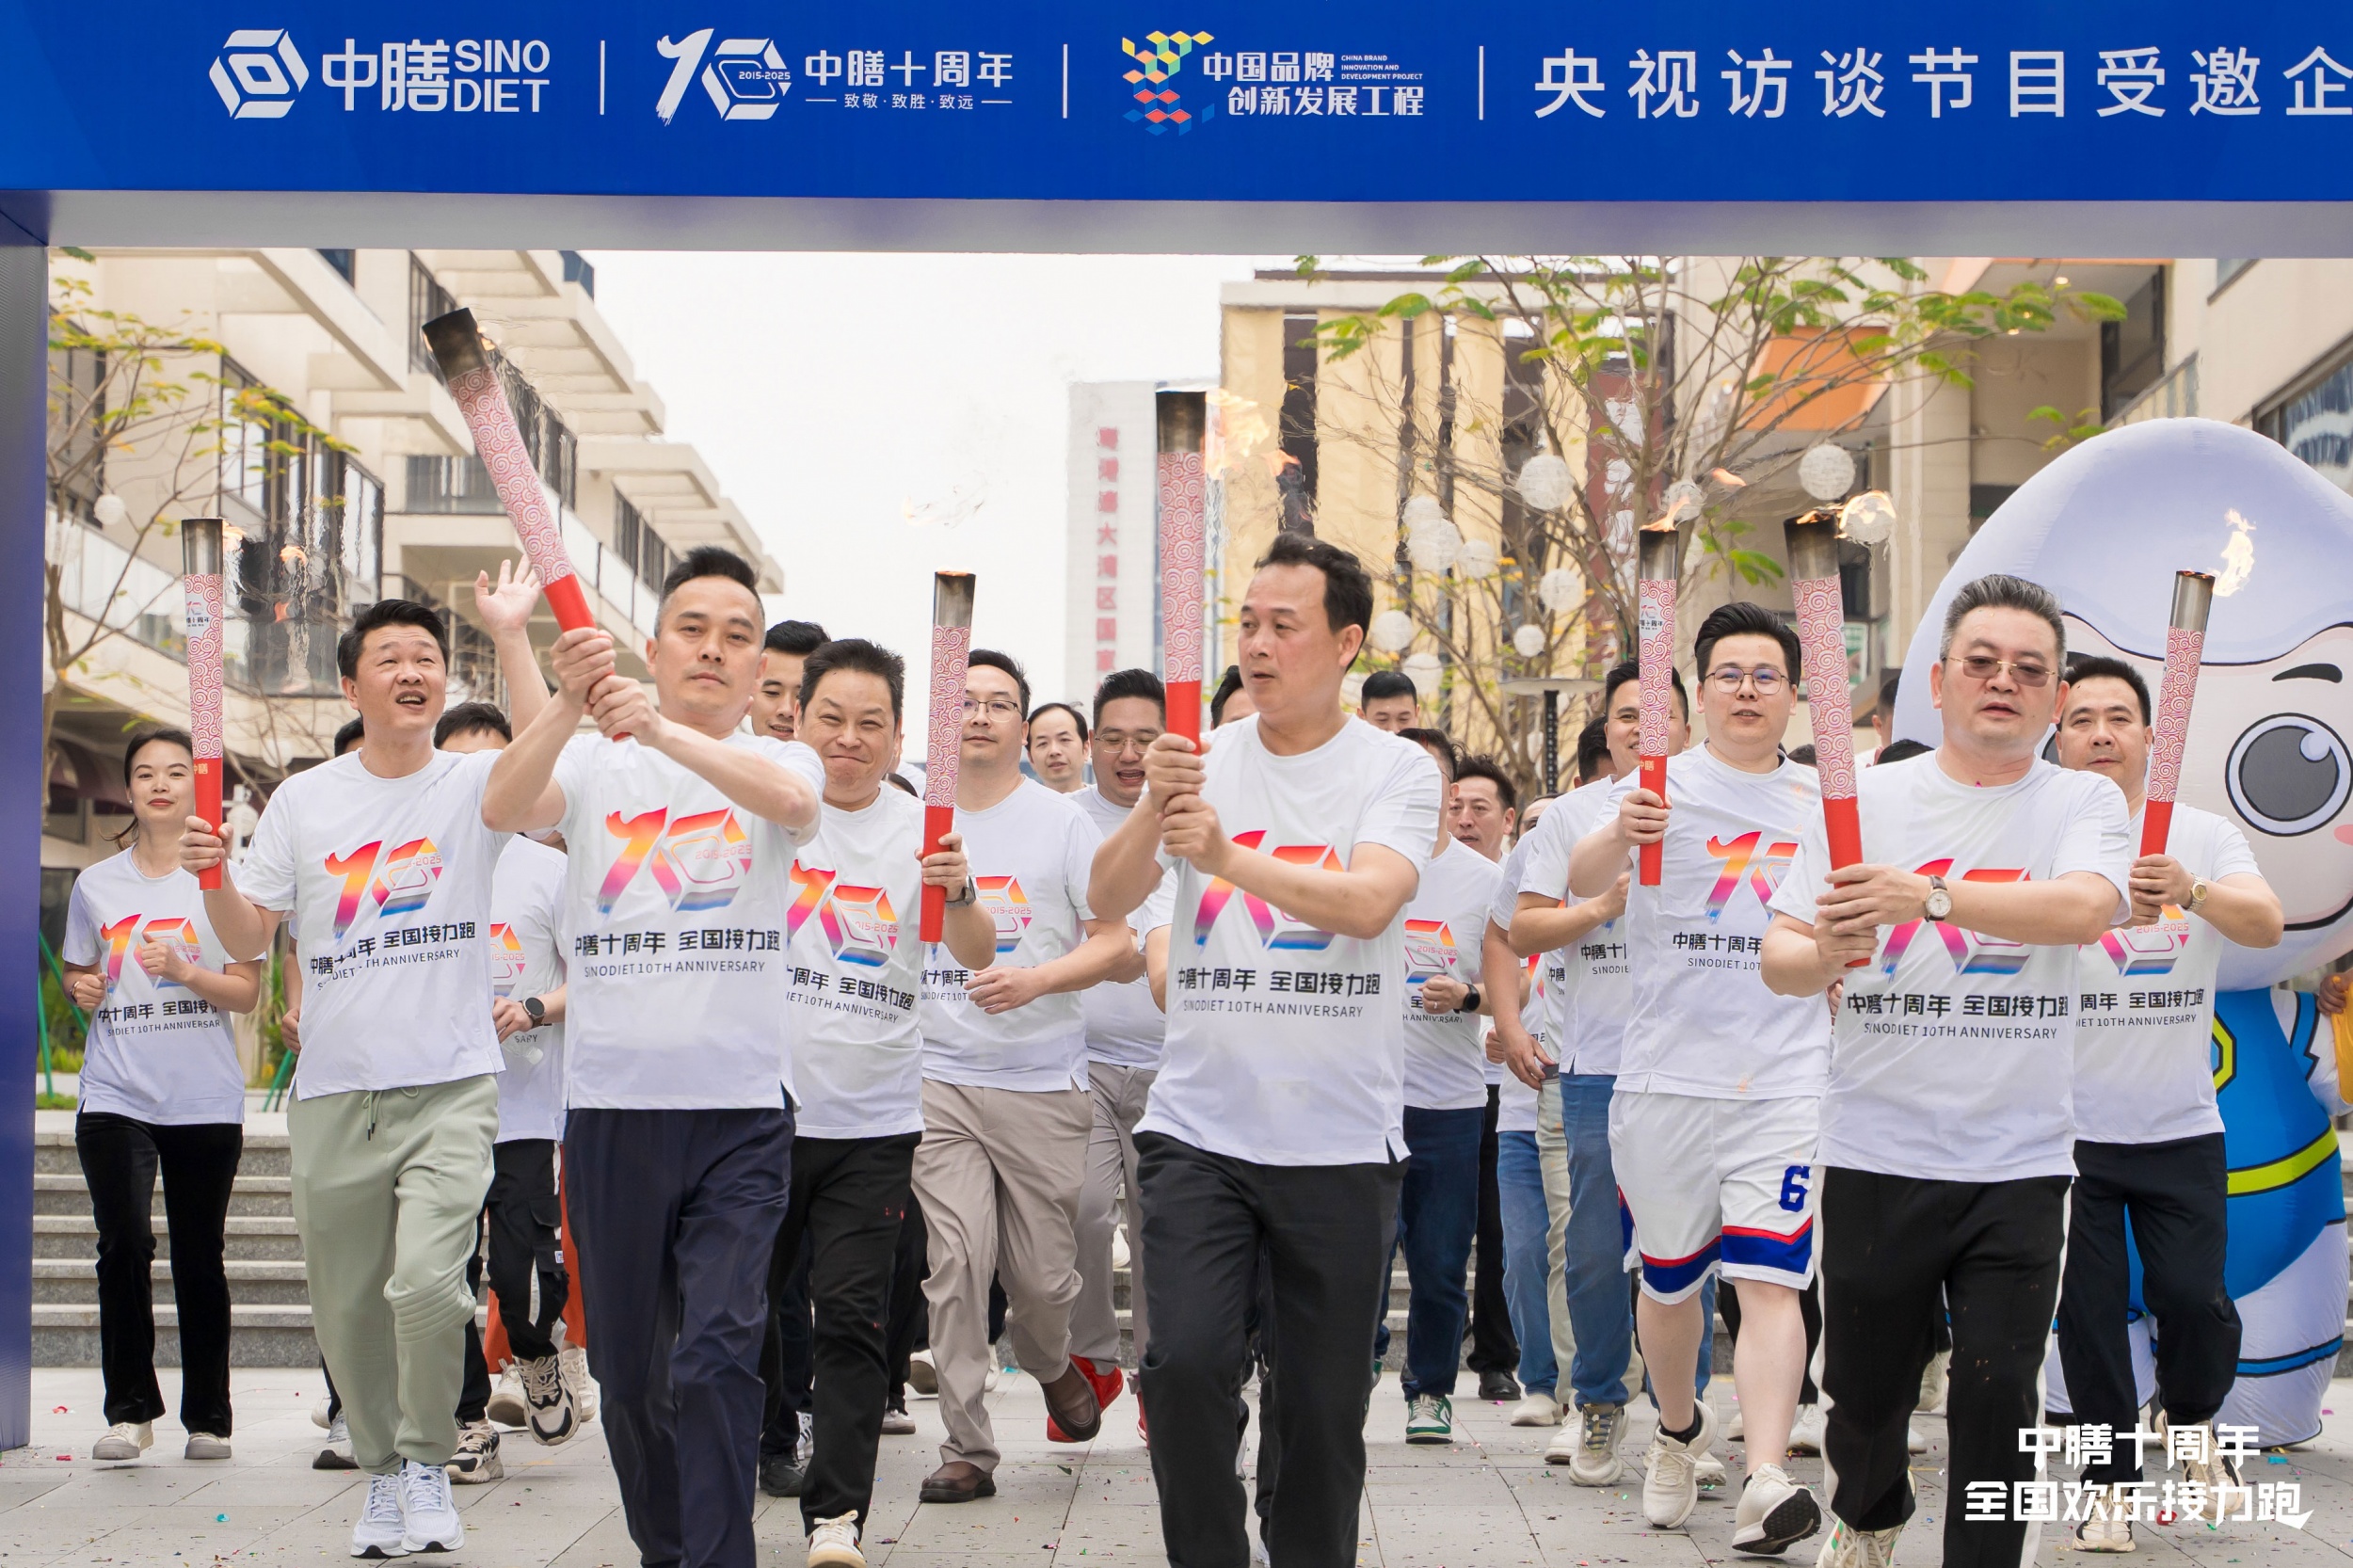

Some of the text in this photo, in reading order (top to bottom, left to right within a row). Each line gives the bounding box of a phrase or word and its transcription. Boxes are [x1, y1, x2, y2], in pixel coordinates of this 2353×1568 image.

[455, 40, 551, 72] SINO
[1203, 52, 1335, 82] 中国品牌
[322, 38, 450, 112] 中膳
[738, 71, 792, 80] 2015-2025
[805, 49, 1013, 88] 中膳十周年
[1533, 46, 2353, 120] 央视访谈节目受邀企
[455, 80, 550, 113] DIET
[1228, 86, 1424, 116] 创新发展工程
[383, 920, 475, 949] 全国接力跑
[2136, 922, 2189, 934] 2015-2025
[574, 928, 780, 956] 中膳十周年 全国接力跑
[1417, 945, 1458, 956] 2015-2025
[1581, 943, 1627, 961] 中膳十
[1672, 931, 1764, 955] 中膳十周年
[382, 949, 460, 968] ANNIVERSARY
[491, 952, 525, 961] 15-2025
[1688, 957, 1762, 971] SINODIET 10T
[584, 960, 765, 978] SINODIET 10TH ANNIVERSARY
[1592, 965, 1629, 975] SINODIE
[839, 976, 916, 1011] 全国接力跑
[1177, 967, 1381, 998] 中膳十周年 全国接力跑
[952, 992, 970, 1001] 10T
[1848, 993, 1952, 1019] 中膳十周年
[2128, 988, 2204, 1009] 全国接力跑
[804, 992, 833, 1009] 10TH
[834, 1001, 900, 1024] ANNIVERSARY
[1183, 999, 1364, 1018] SINODIET 10TH ANNIVERSARY
[137, 1024, 161, 1033] 10TH
[163, 1019, 221, 1031] ANNIVERSAR
[1864, 1022, 2057, 1040] SINODIET 10TH ANNIVERSARY
[2097, 1016, 2125, 1027] 10TH
[2128, 1014, 2197, 1027] ANNIVERSARY
[1778, 1165, 1811, 1213] 6
